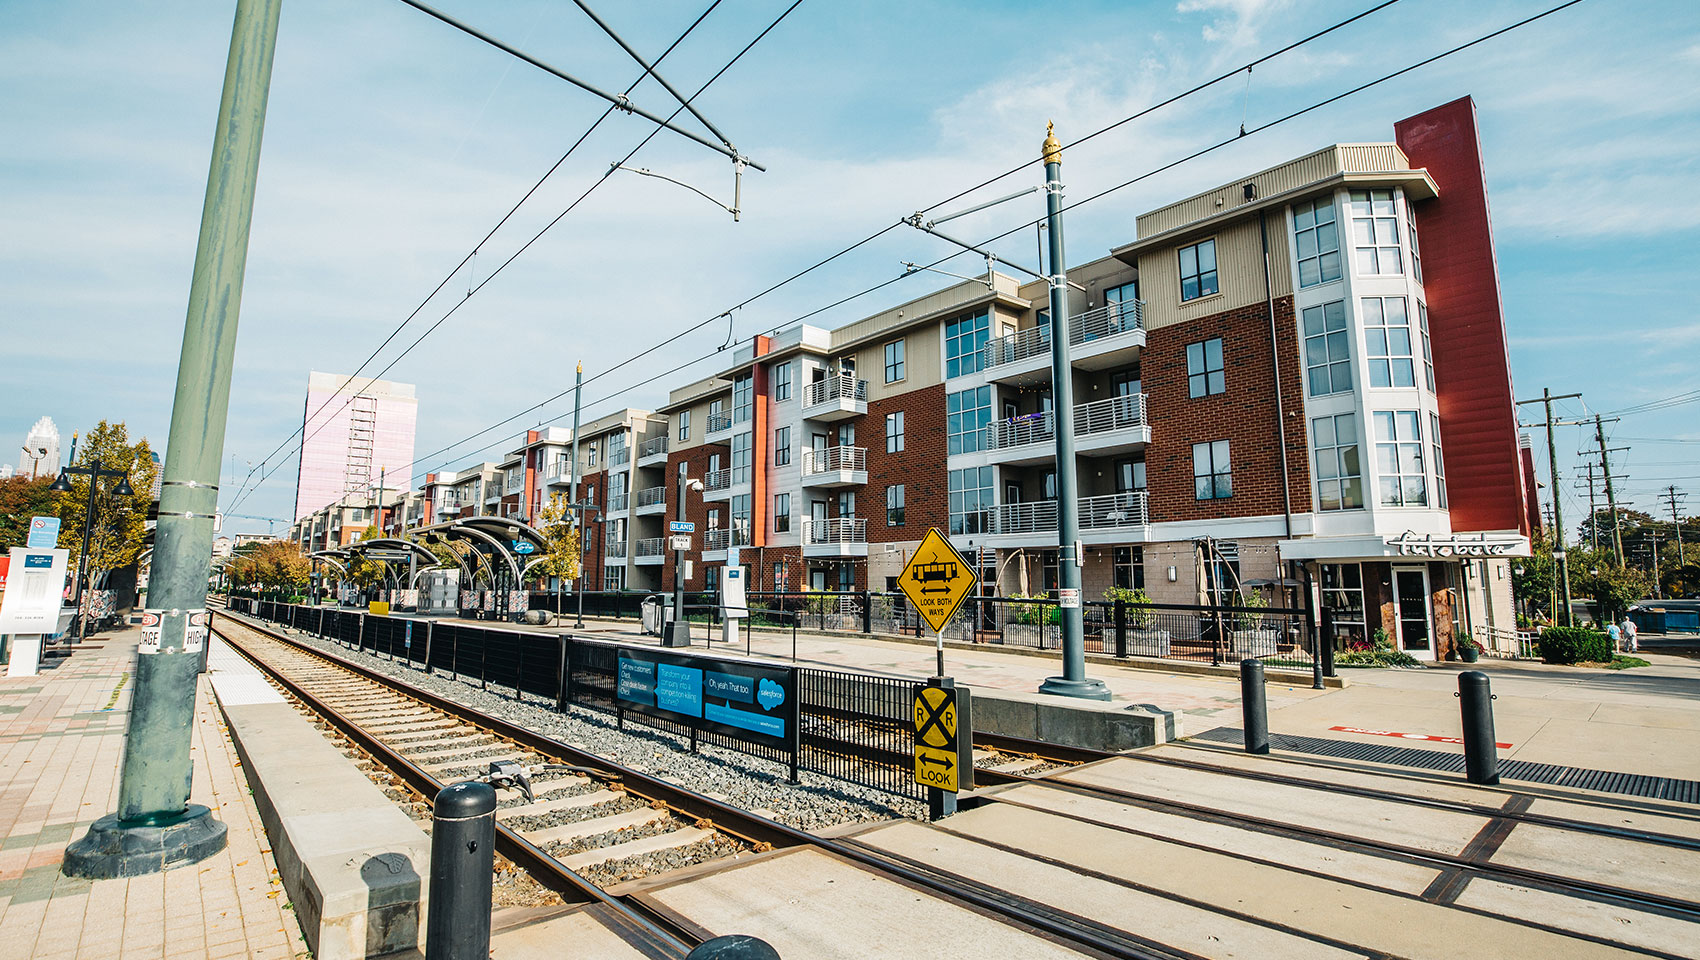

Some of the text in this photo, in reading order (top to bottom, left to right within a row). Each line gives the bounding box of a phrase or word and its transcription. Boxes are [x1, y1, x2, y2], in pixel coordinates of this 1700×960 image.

[920, 598, 952, 606] LOOK BOTH
[929, 607, 944, 617] WAYS
[708, 678, 717, 689] Oh,
[729, 682, 740, 692] That
[760, 689, 783, 699] salesforce
[917, 707, 954, 727] R R
[920, 768, 951, 786] LOOK
